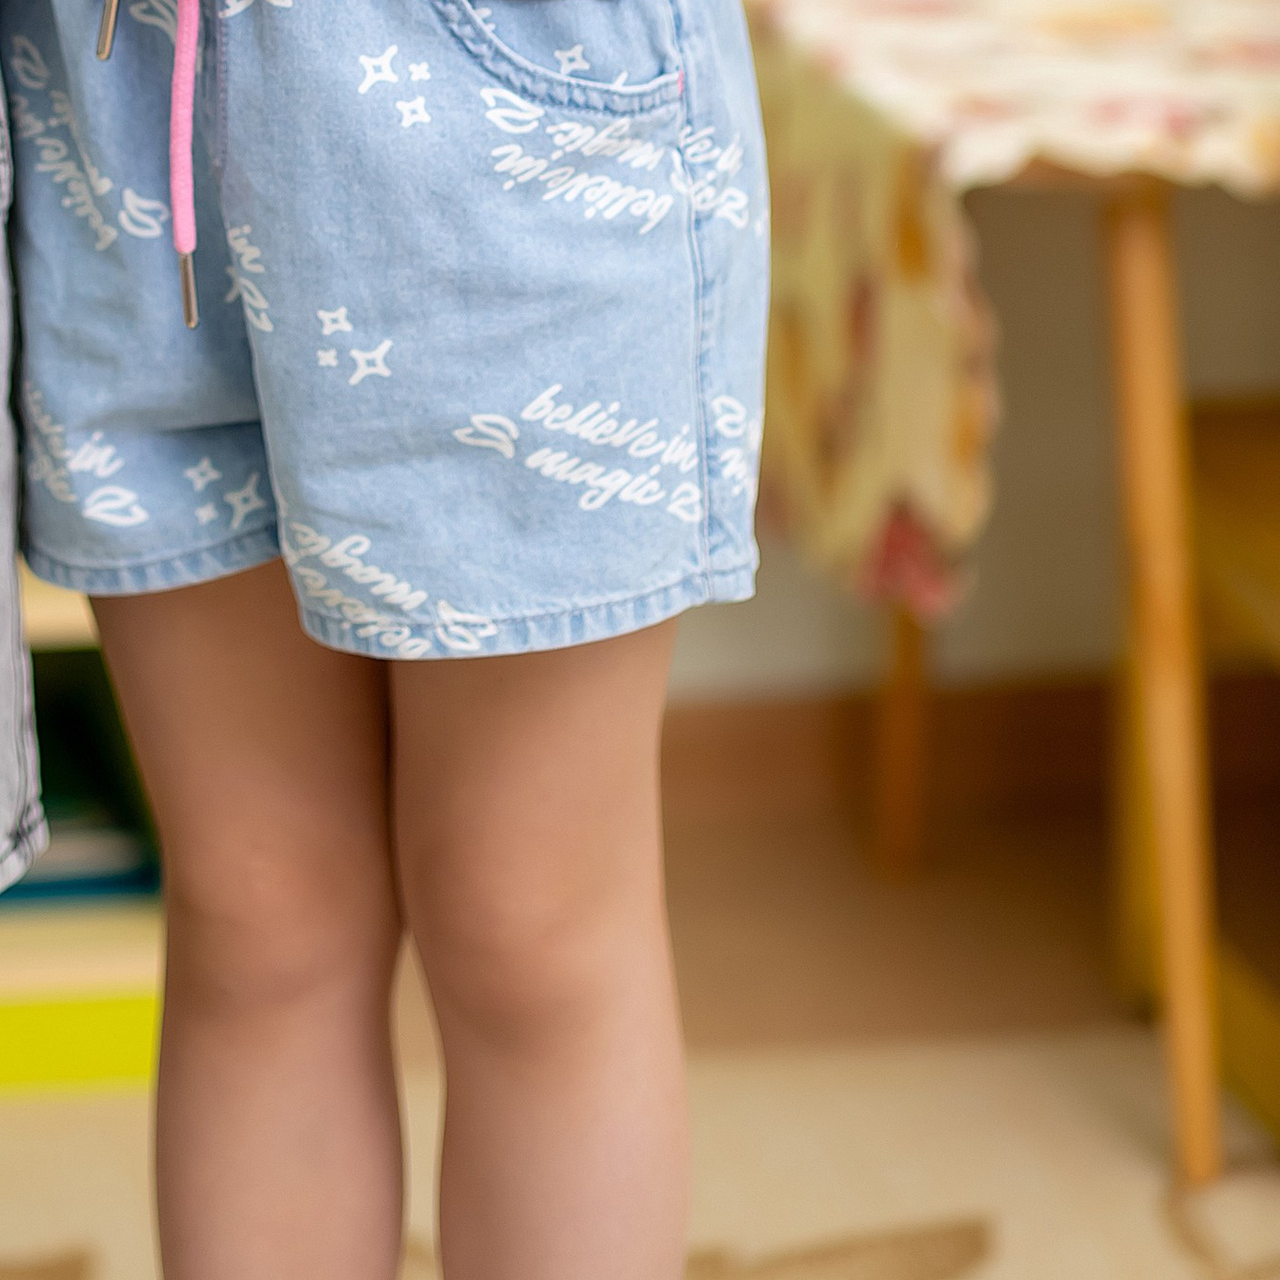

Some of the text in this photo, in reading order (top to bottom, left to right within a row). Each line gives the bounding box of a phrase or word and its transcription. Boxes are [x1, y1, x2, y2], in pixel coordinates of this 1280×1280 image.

[521, 382, 699, 474] believe in
[524, 446, 666, 512] magic
